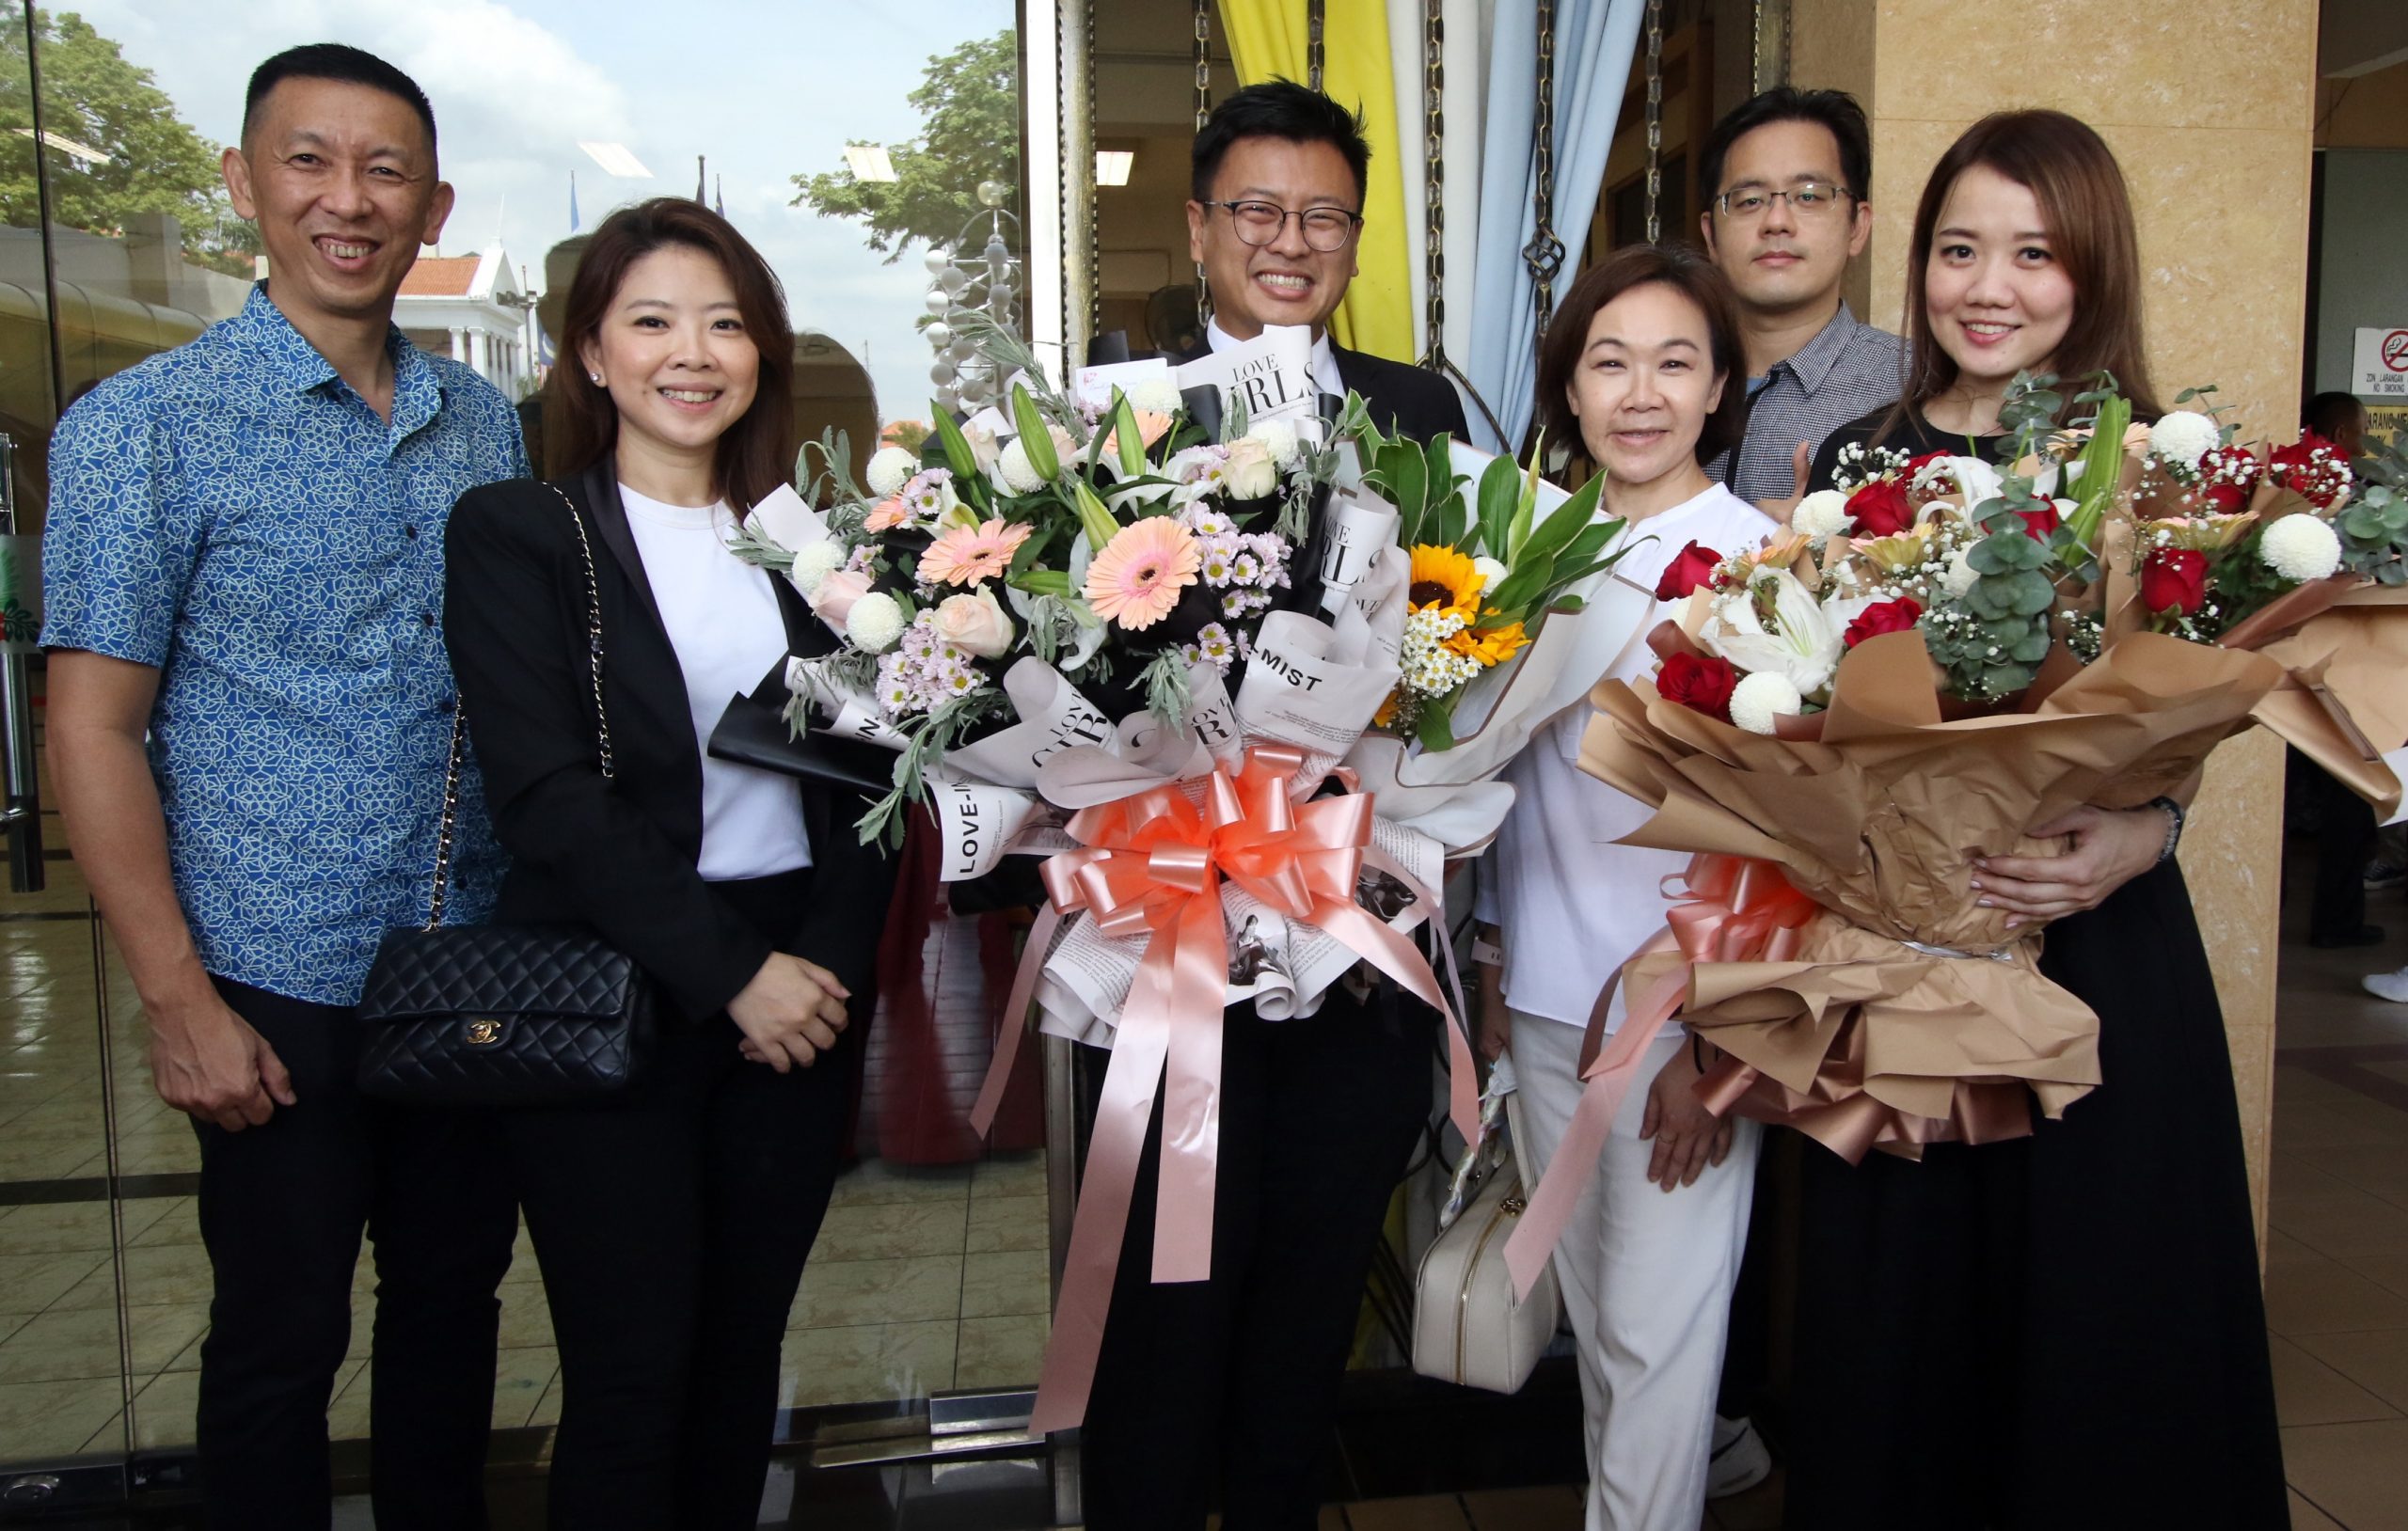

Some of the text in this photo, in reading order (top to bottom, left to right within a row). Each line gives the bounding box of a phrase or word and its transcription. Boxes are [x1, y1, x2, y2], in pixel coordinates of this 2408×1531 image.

[1233, 354, 1278, 382] LOVE
[2373, 383, 2405, 392] NO SMOKING
[2379, 373, 2403, 383] LARANGAN
[1227, 362, 1315, 416] RLS
